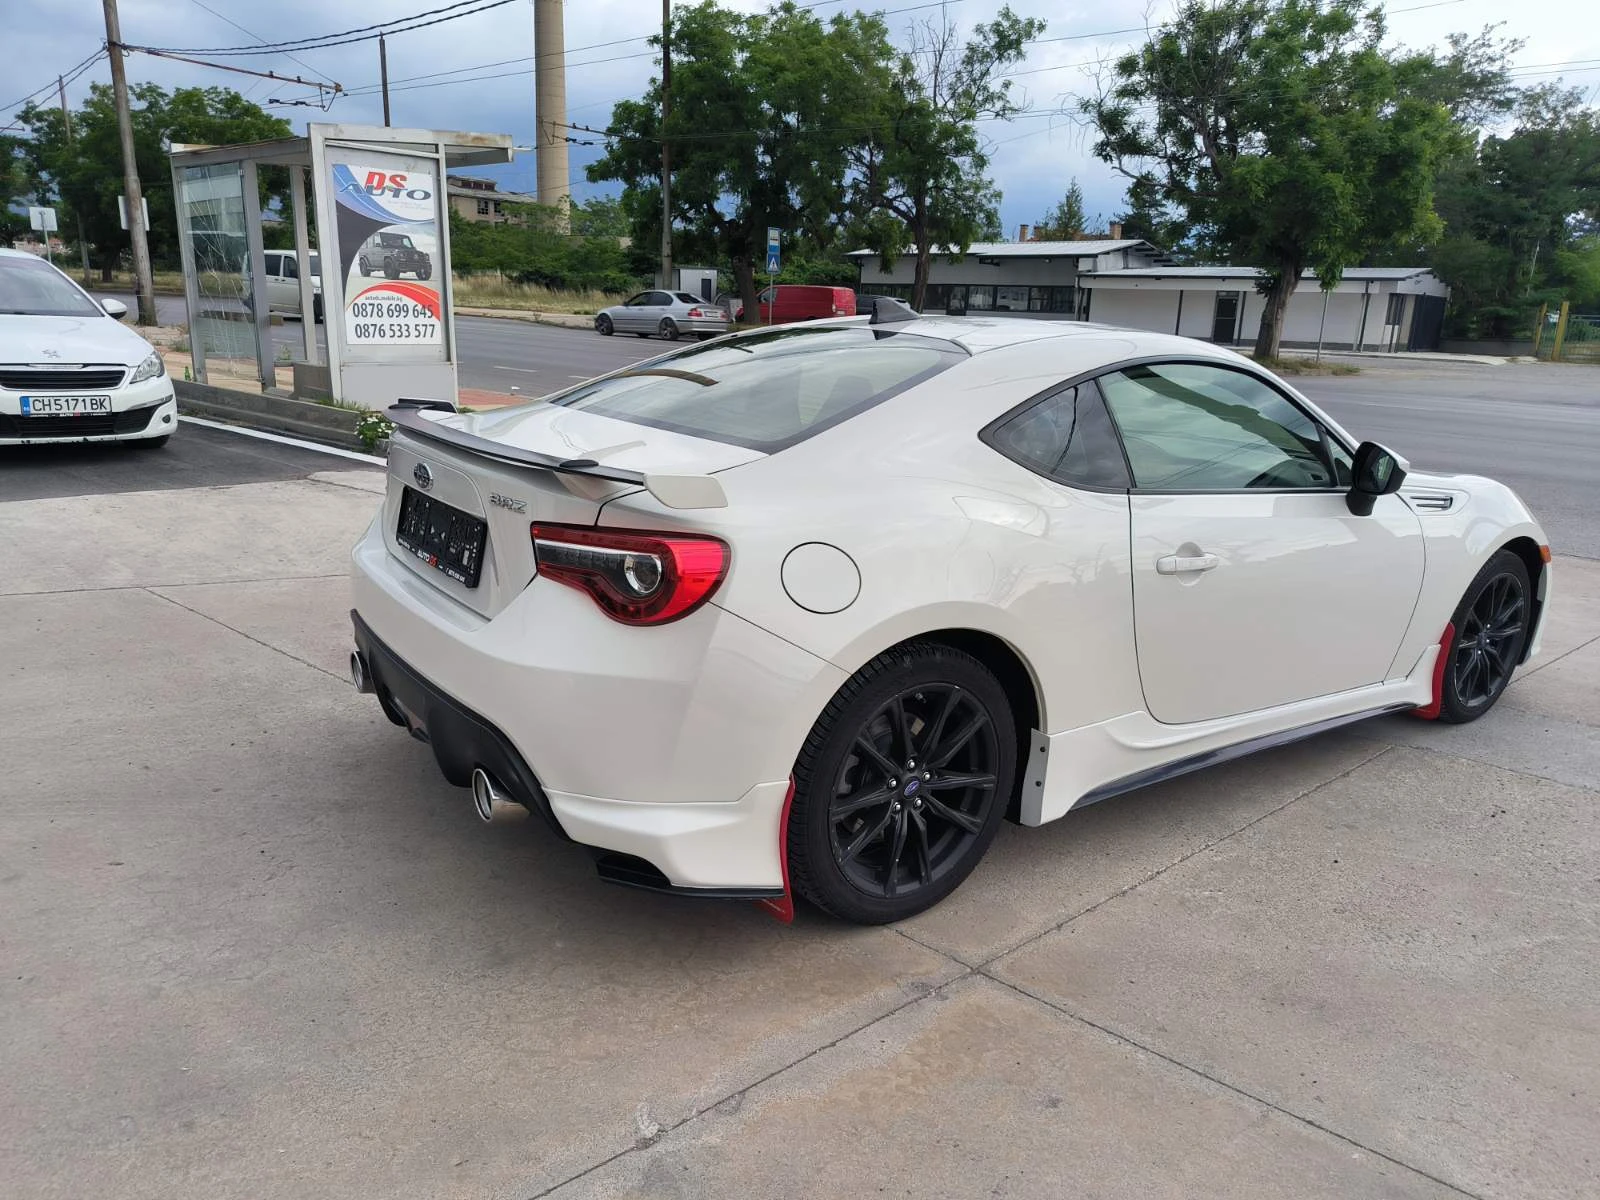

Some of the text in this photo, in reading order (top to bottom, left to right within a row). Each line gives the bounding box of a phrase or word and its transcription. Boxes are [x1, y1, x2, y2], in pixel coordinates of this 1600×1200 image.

[365, 171, 407, 192] DS
[340, 183, 431, 200] AUTO
[352, 302, 434, 318] 0878 699 645
[355, 323, 435, 338] 0876 533 577
